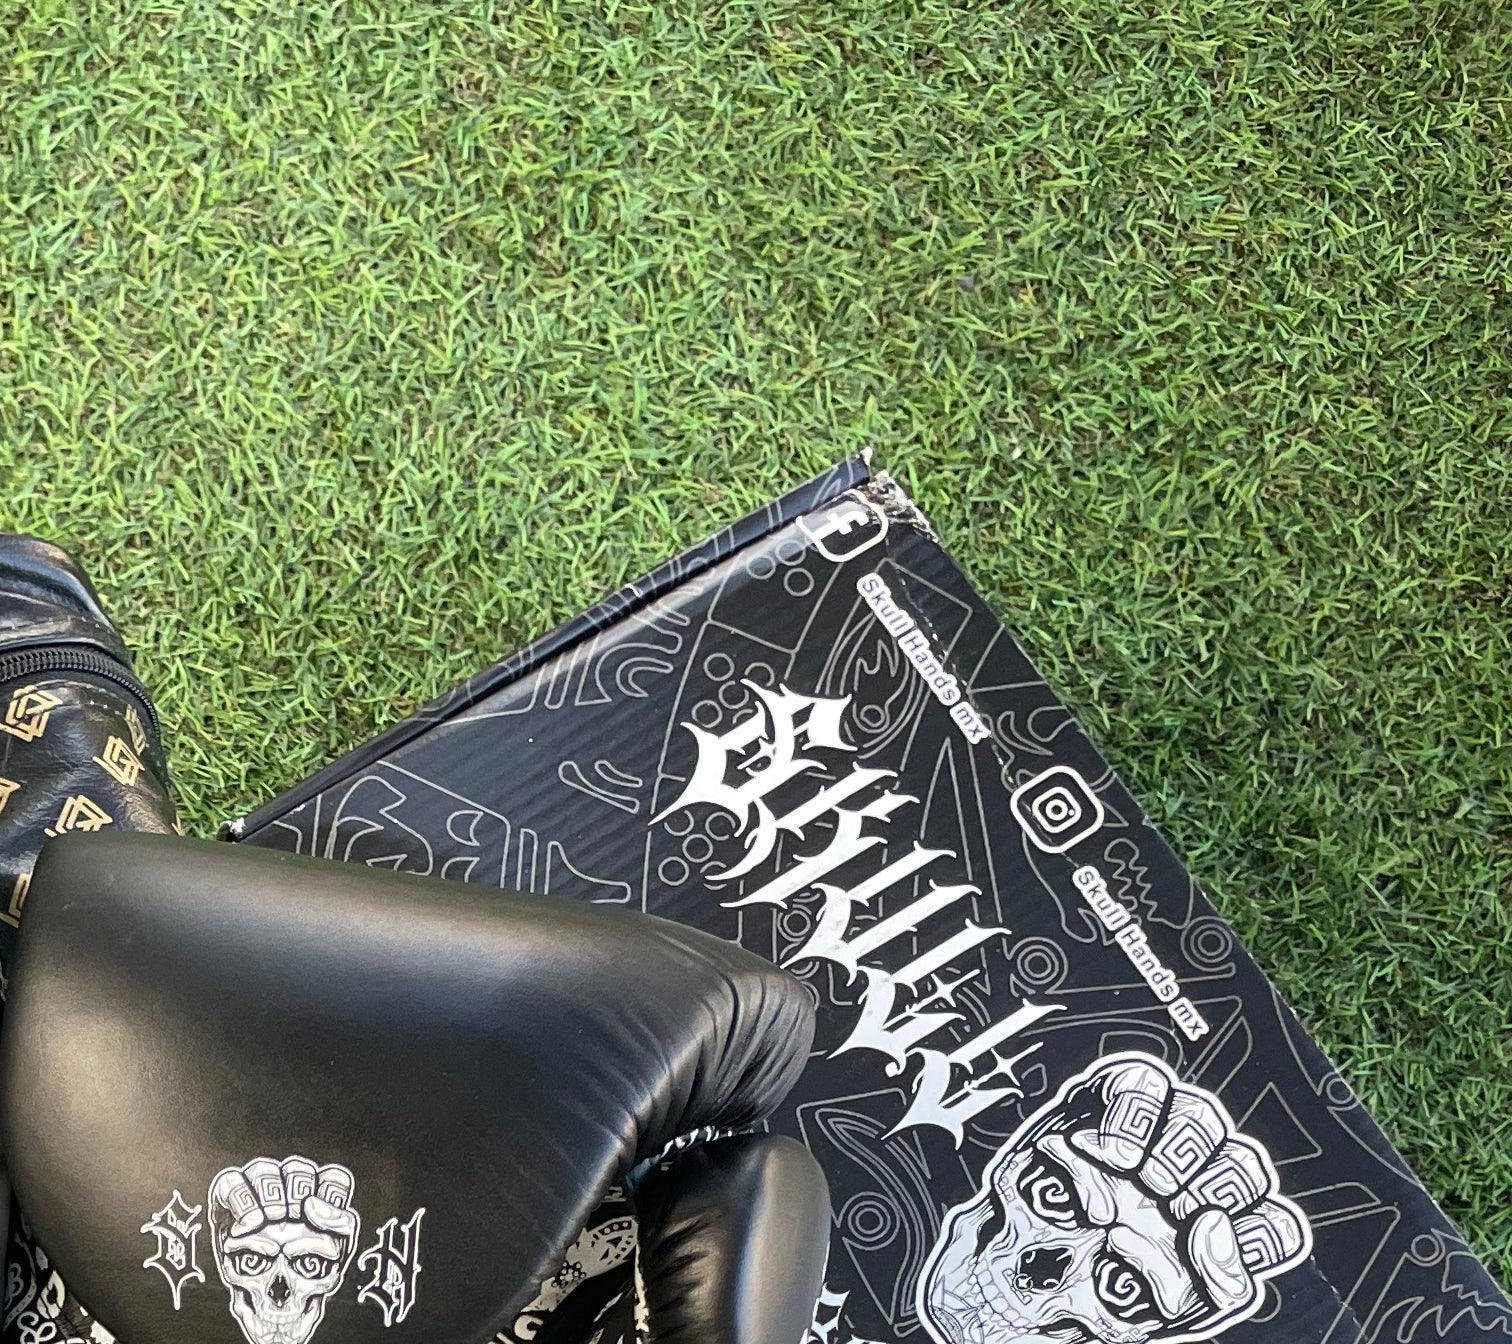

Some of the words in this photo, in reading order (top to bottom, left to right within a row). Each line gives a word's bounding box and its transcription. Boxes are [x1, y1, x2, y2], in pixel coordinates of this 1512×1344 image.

[858, 574, 911, 637] Skull
[900, 633, 955, 704] Hands
[951, 701, 991, 743] mx
[1074, 866, 1131, 931] Skull
[1117, 927, 1175, 999] Hands
[1169, 994, 1208, 1041] mx
